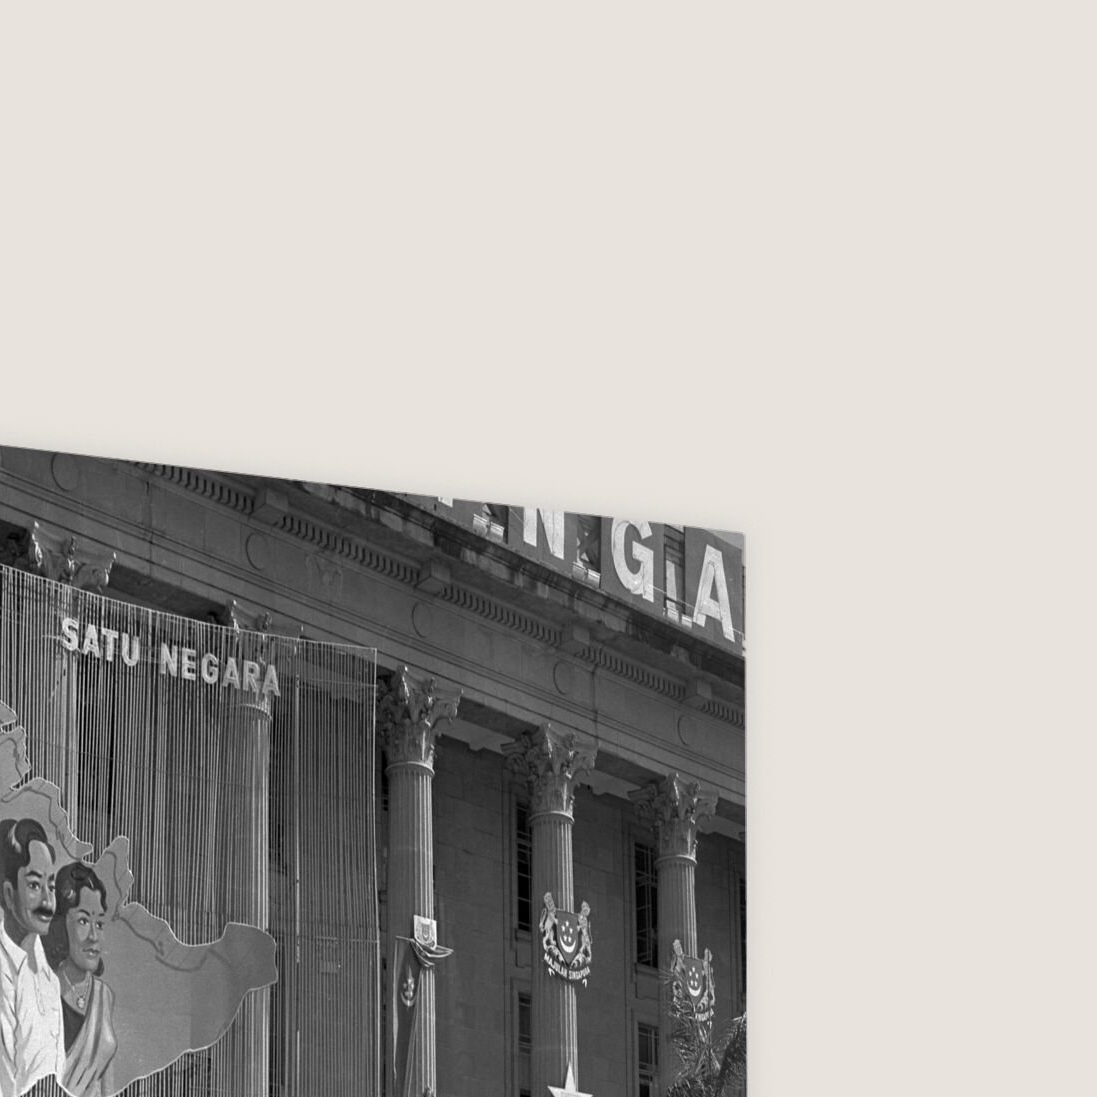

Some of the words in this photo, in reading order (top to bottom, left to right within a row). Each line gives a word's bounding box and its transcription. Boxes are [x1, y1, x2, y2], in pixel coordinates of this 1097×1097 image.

[438, 497, 736, 643] NGA
[61, 617, 141, 667] SATU
[159, 642, 281, 697] NEGARA
